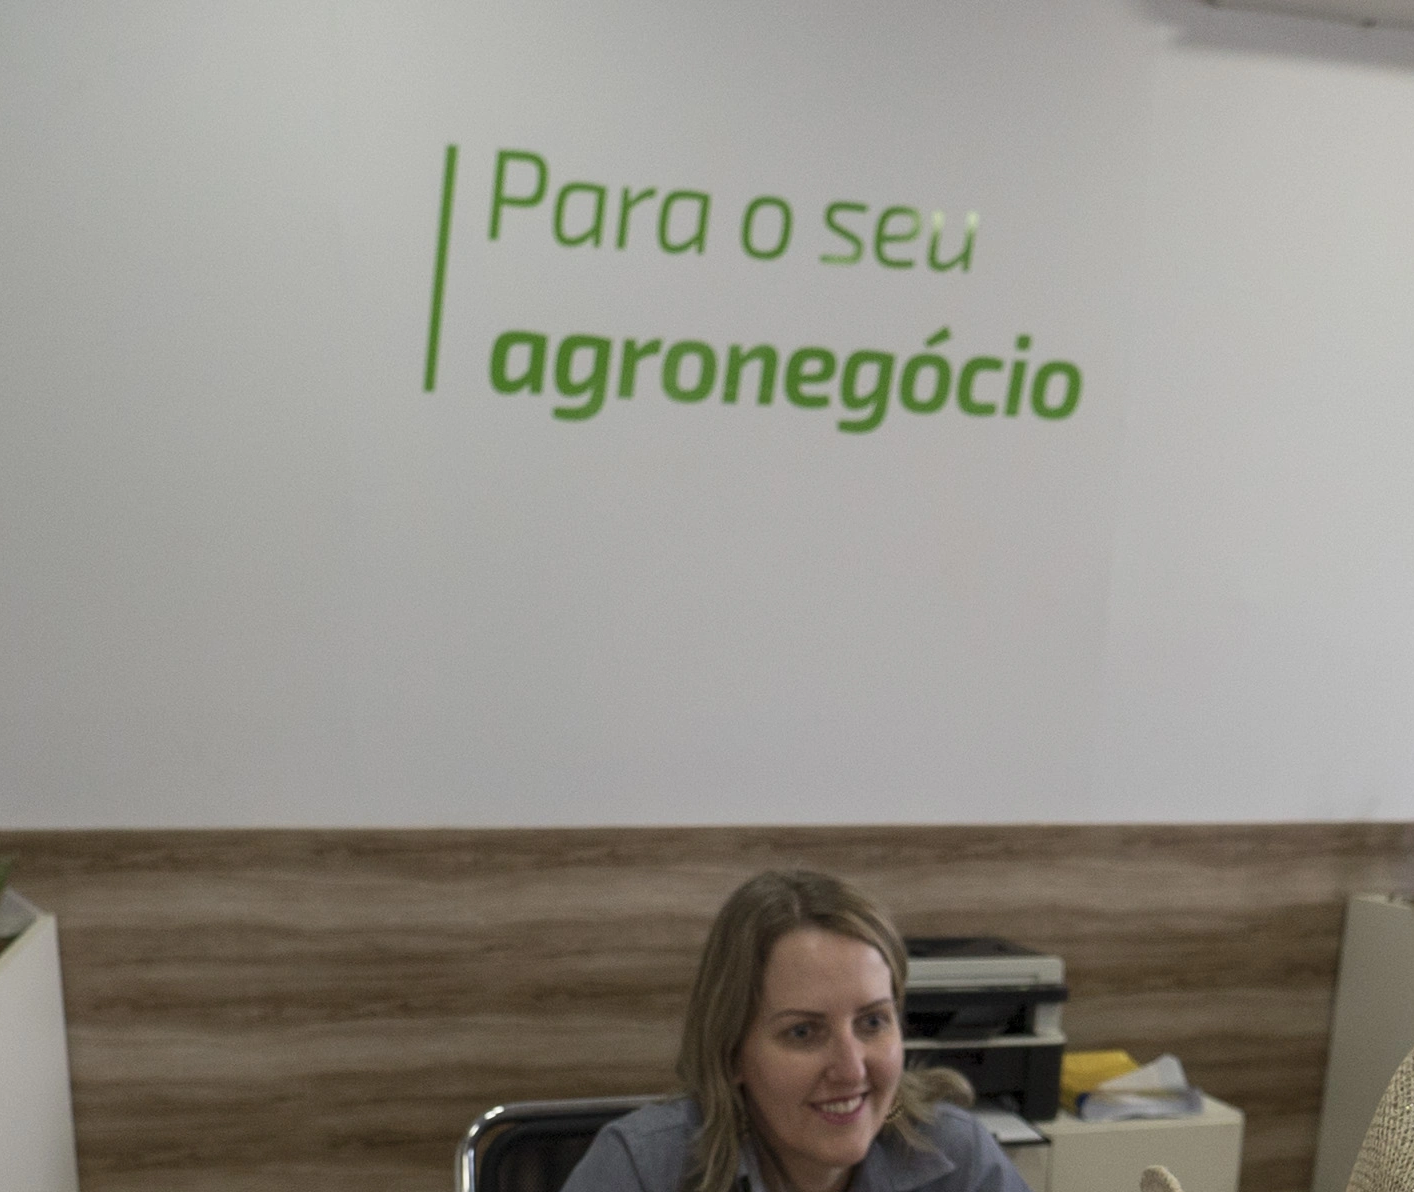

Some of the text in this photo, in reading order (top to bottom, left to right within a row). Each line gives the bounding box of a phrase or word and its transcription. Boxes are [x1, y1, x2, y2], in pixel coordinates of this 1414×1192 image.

[488, 148, 979, 273] Para o seu
[489, 325, 1083, 434] agronegócio
